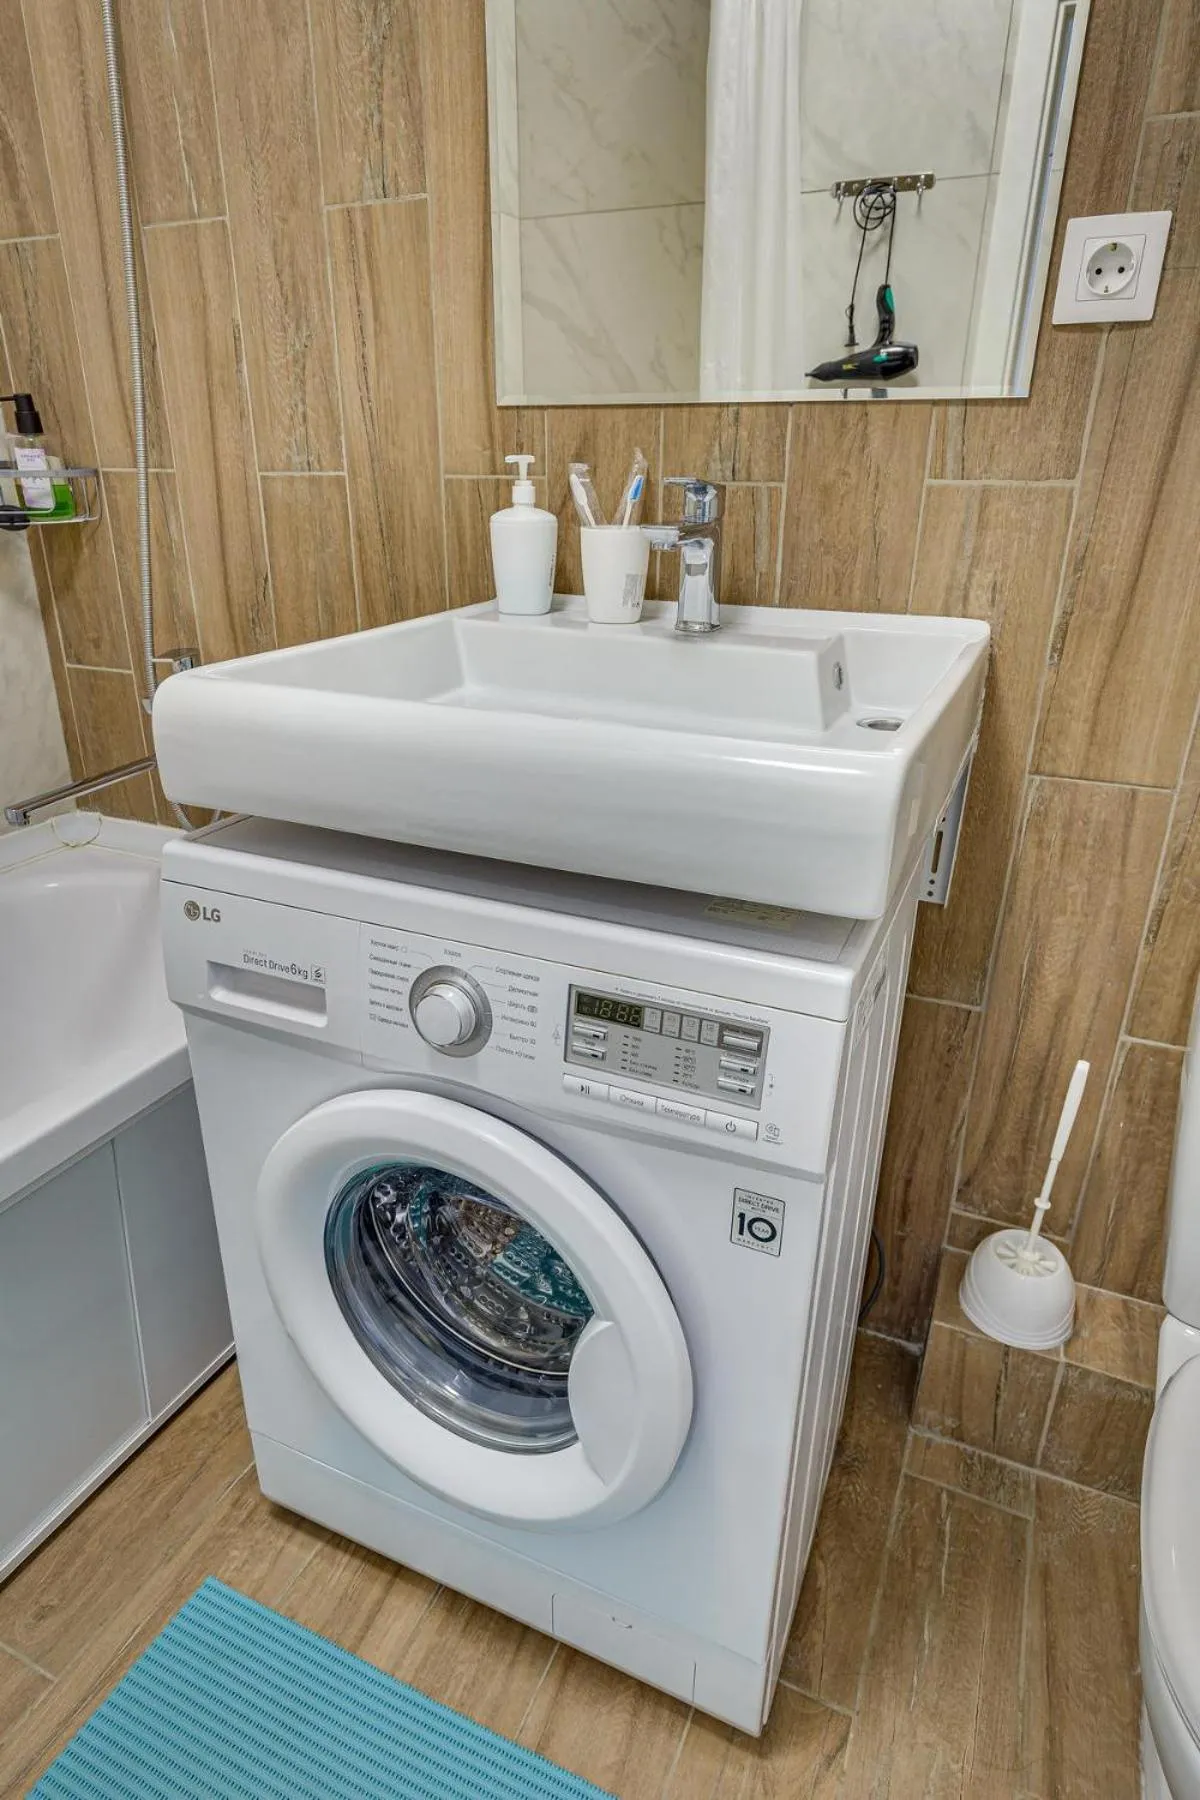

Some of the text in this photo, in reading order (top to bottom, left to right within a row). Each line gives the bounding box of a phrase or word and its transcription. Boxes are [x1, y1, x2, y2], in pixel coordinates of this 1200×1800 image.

[202, 906, 221, 923] LG
[243, 953, 268, 968] Direct
[737, 1212, 777, 1243] 10
